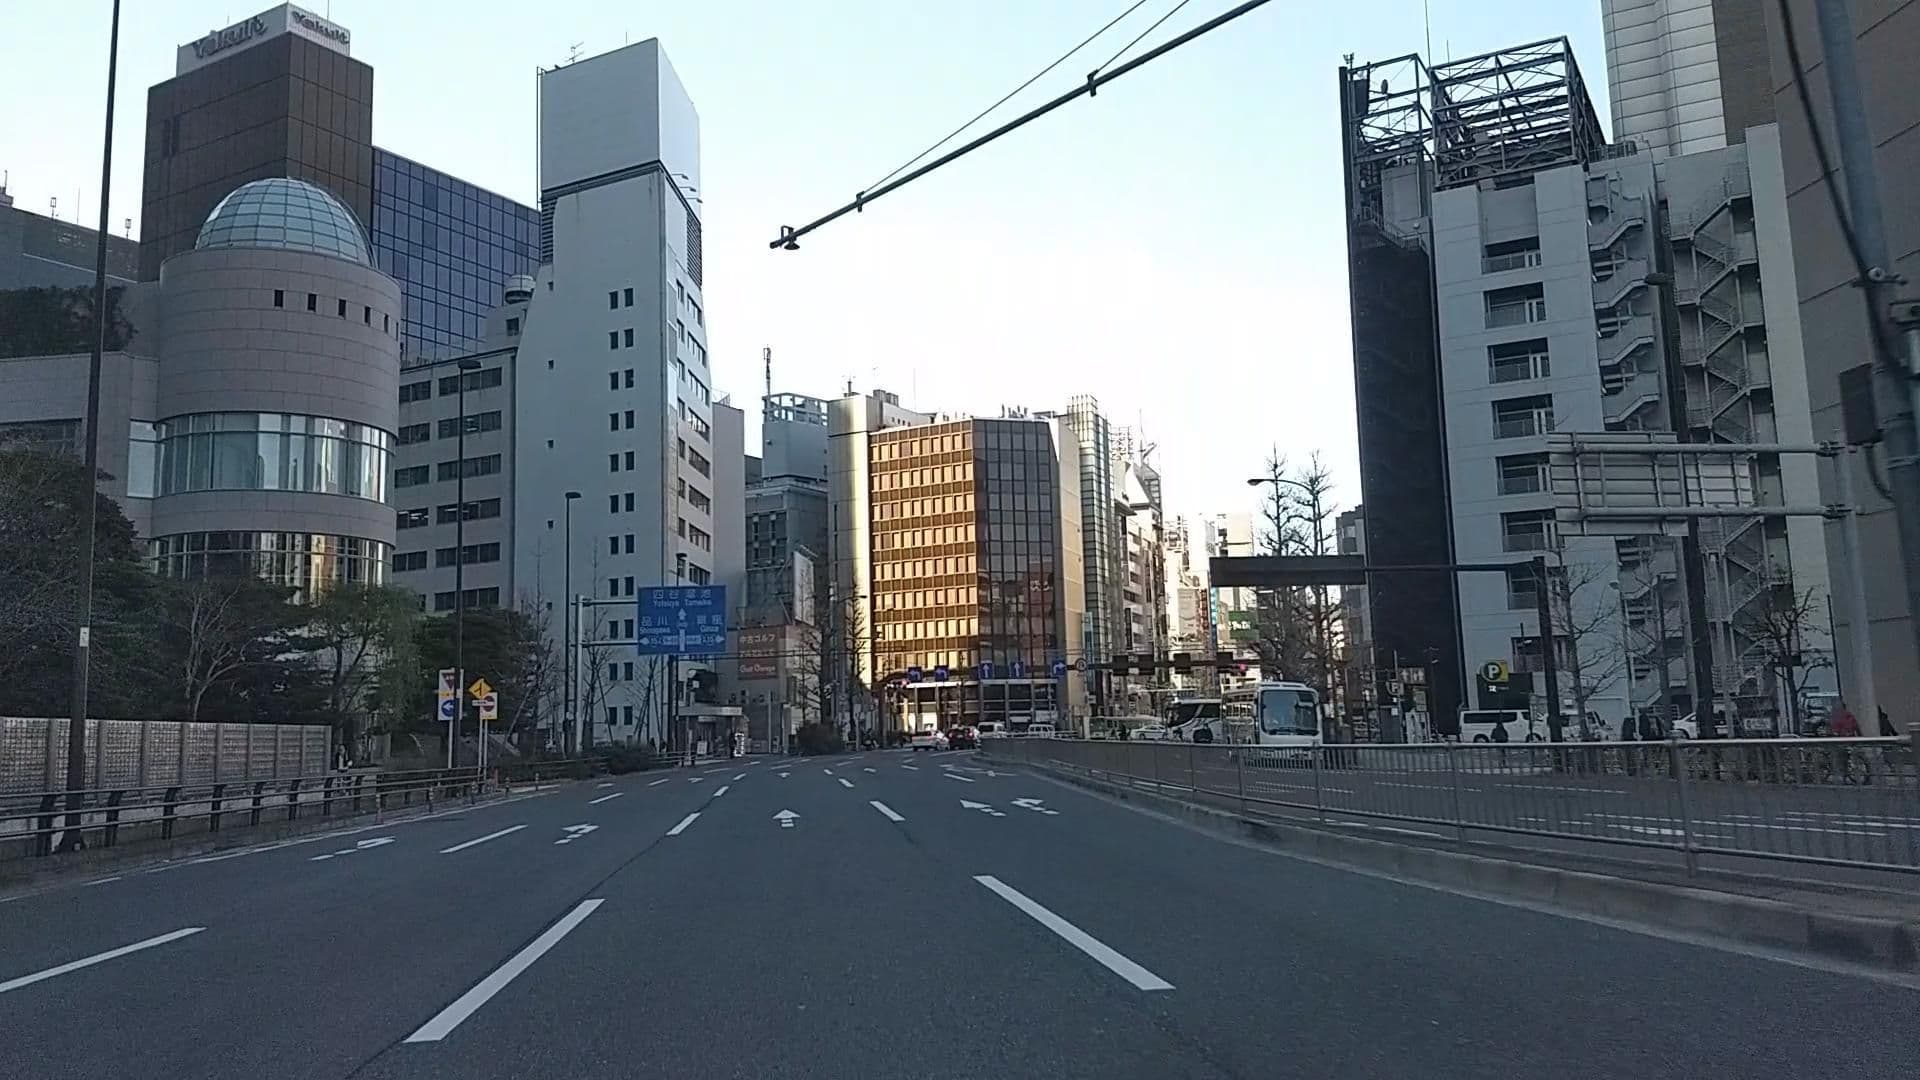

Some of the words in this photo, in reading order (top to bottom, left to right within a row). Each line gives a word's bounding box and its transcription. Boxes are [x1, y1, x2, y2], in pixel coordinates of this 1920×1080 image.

[192, 15, 268, 59] Yakult
[292, 11, 350, 45] Yakult
[641, 616, 668, 626] 品川
[1488, 665, 1499, 679] P
